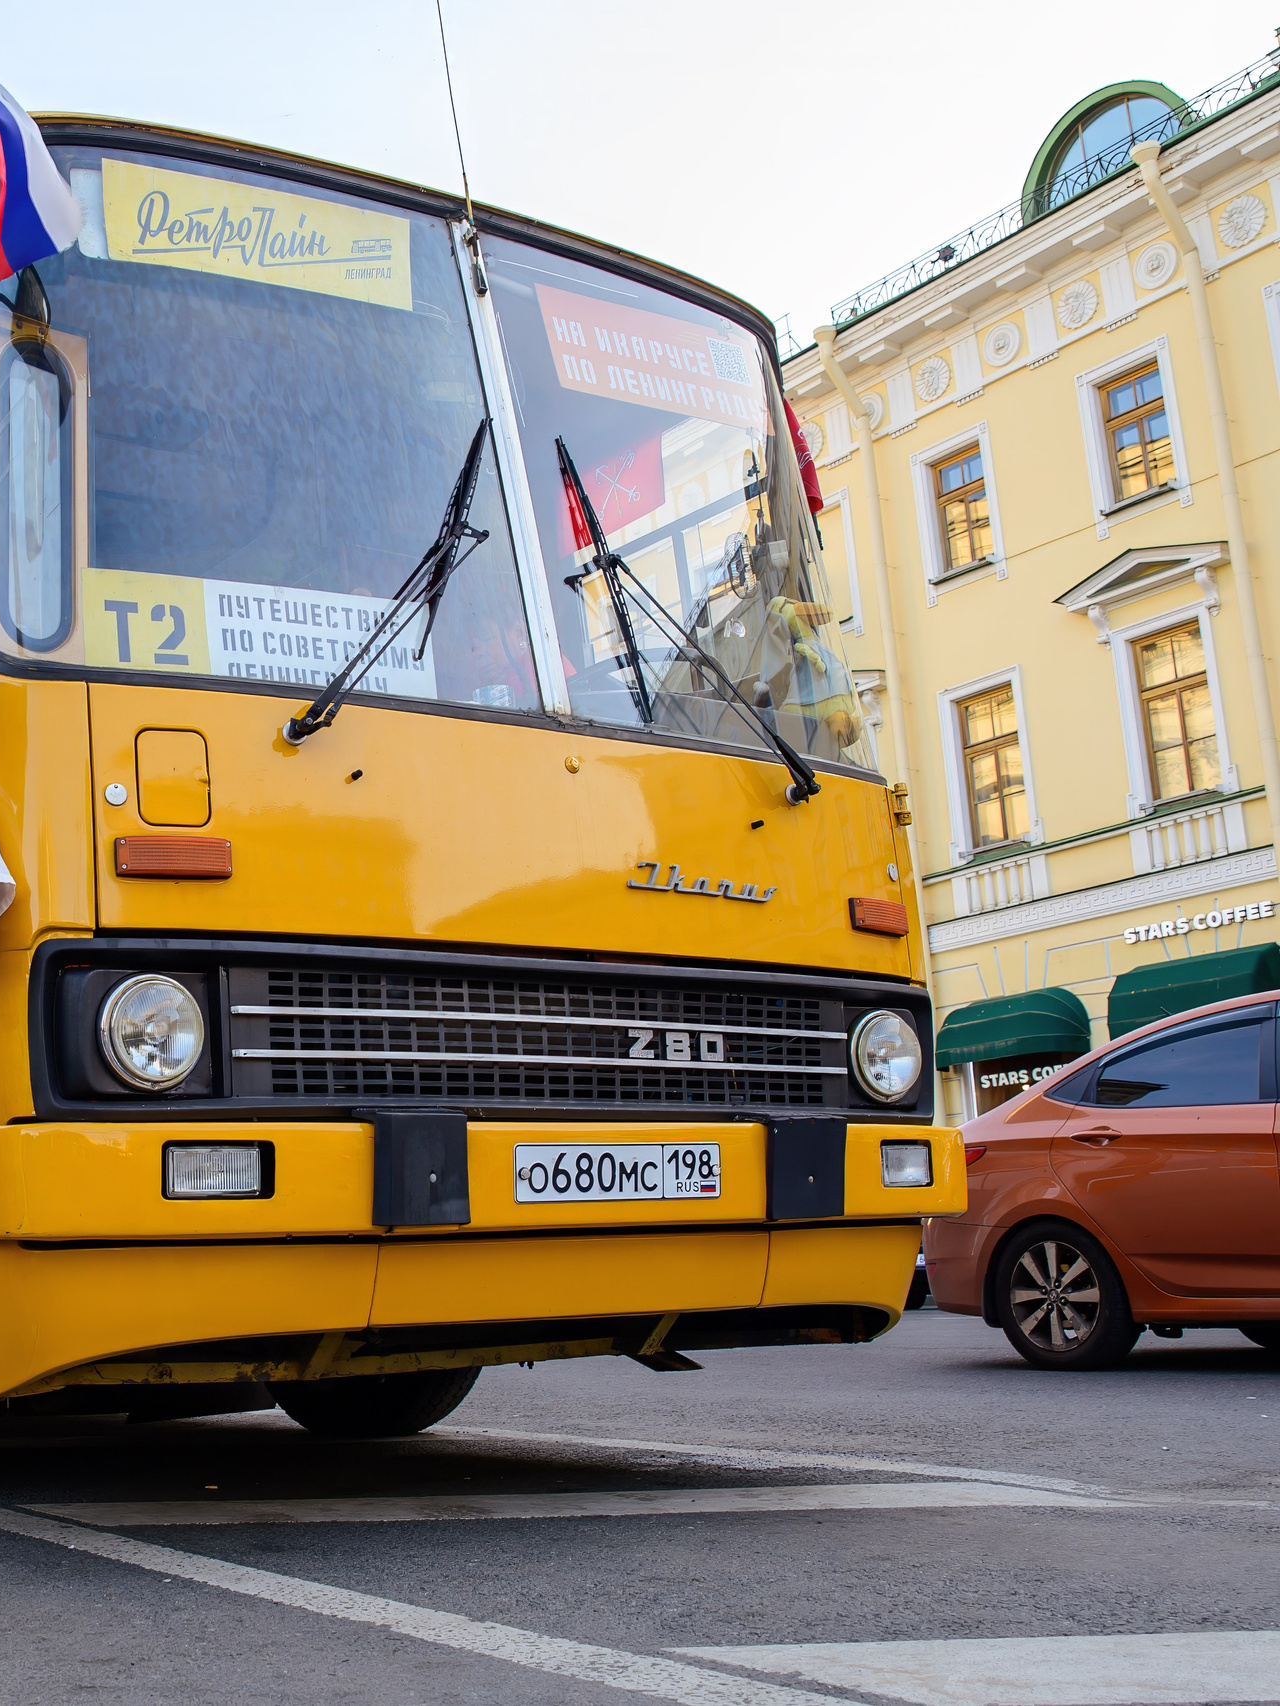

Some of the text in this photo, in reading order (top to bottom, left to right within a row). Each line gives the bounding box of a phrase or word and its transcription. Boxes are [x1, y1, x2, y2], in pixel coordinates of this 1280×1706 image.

[343, 267, 392, 281] ЛЕНИНГРАД
[552, 316, 713, 378] НА ИКАРУСЕ
[562, 353, 762, 423] ПО ЛЕНИНГРАДУ
[221, 627, 255, 653] ПО
[626, 860, 778, 904] Ikarus
[1123, 900, 1276, 945] STARS COFFEE
[980, 1063, 1069, 1089] STARS COF
[666, 1149, 713, 1180] 198
[676, 1181, 700, 1193] RUS
